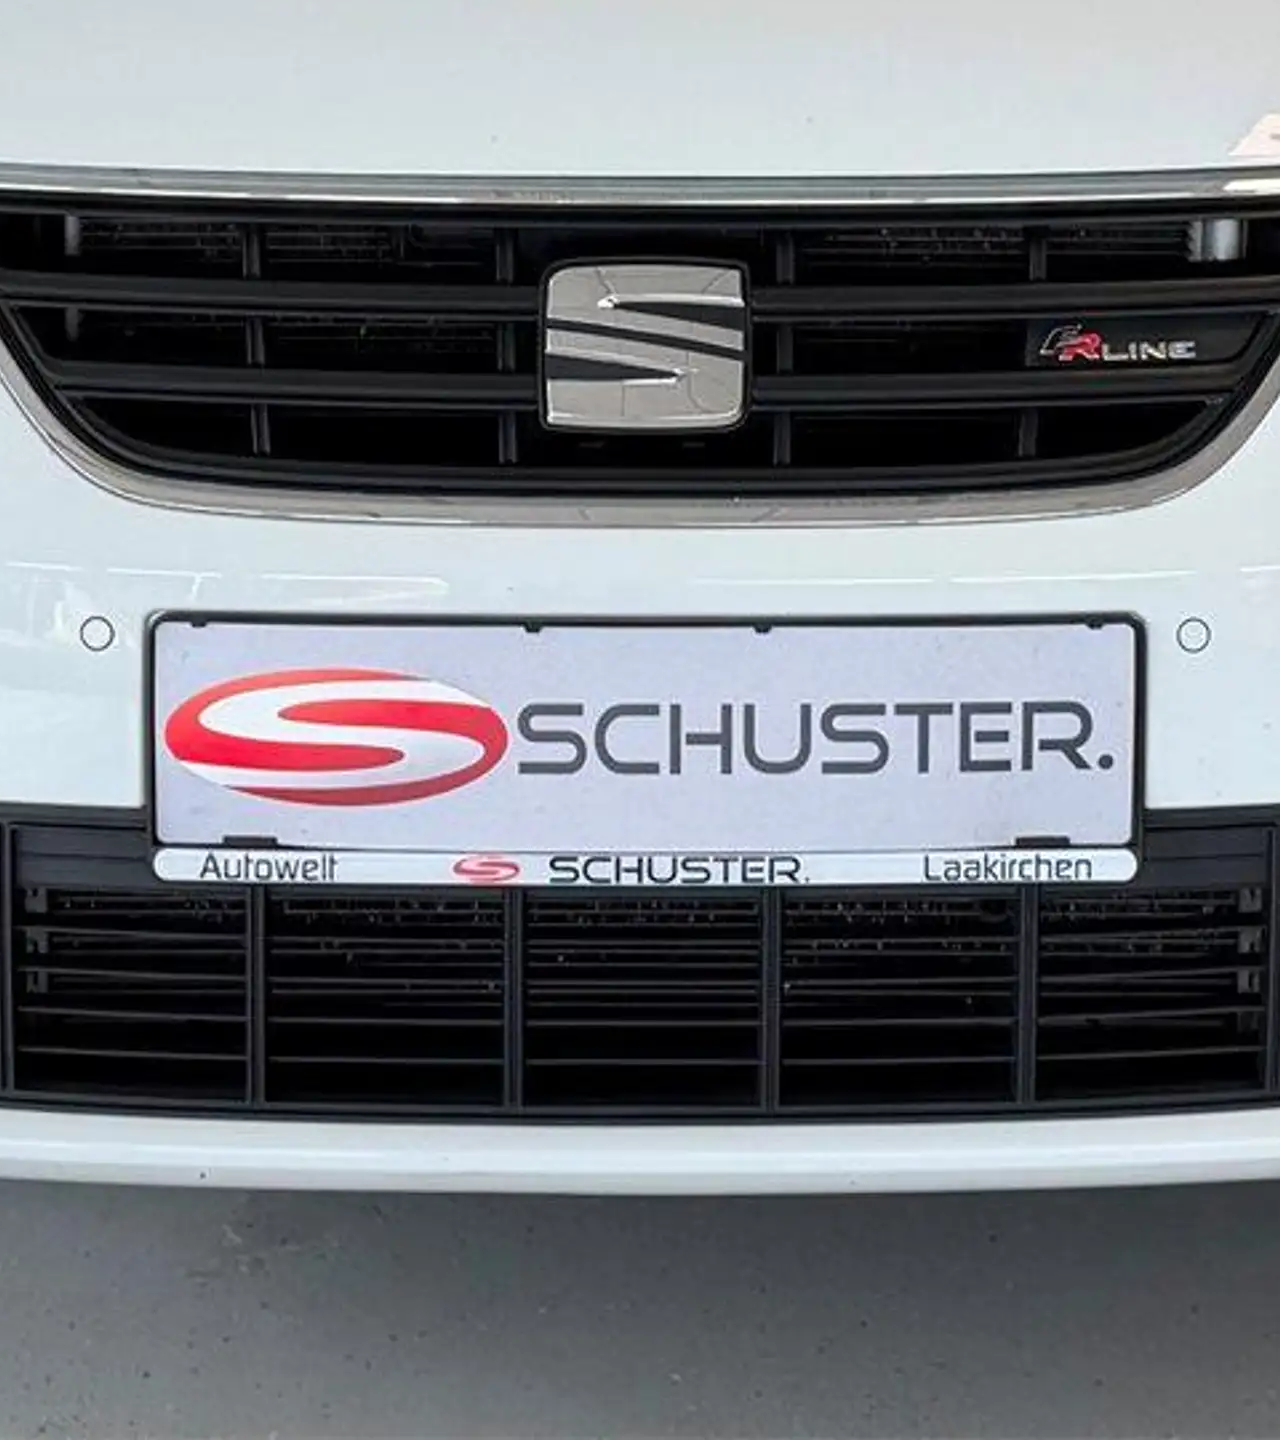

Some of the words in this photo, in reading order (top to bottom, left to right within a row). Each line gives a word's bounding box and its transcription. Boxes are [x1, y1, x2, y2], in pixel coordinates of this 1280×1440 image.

[517, 700, 1116, 775] SCHUSTER.
[200, 852, 338, 881] Autowelt
[549, 855, 811, 884] SCHUSTER.
[924, 851, 1093, 881] Laakirchen
